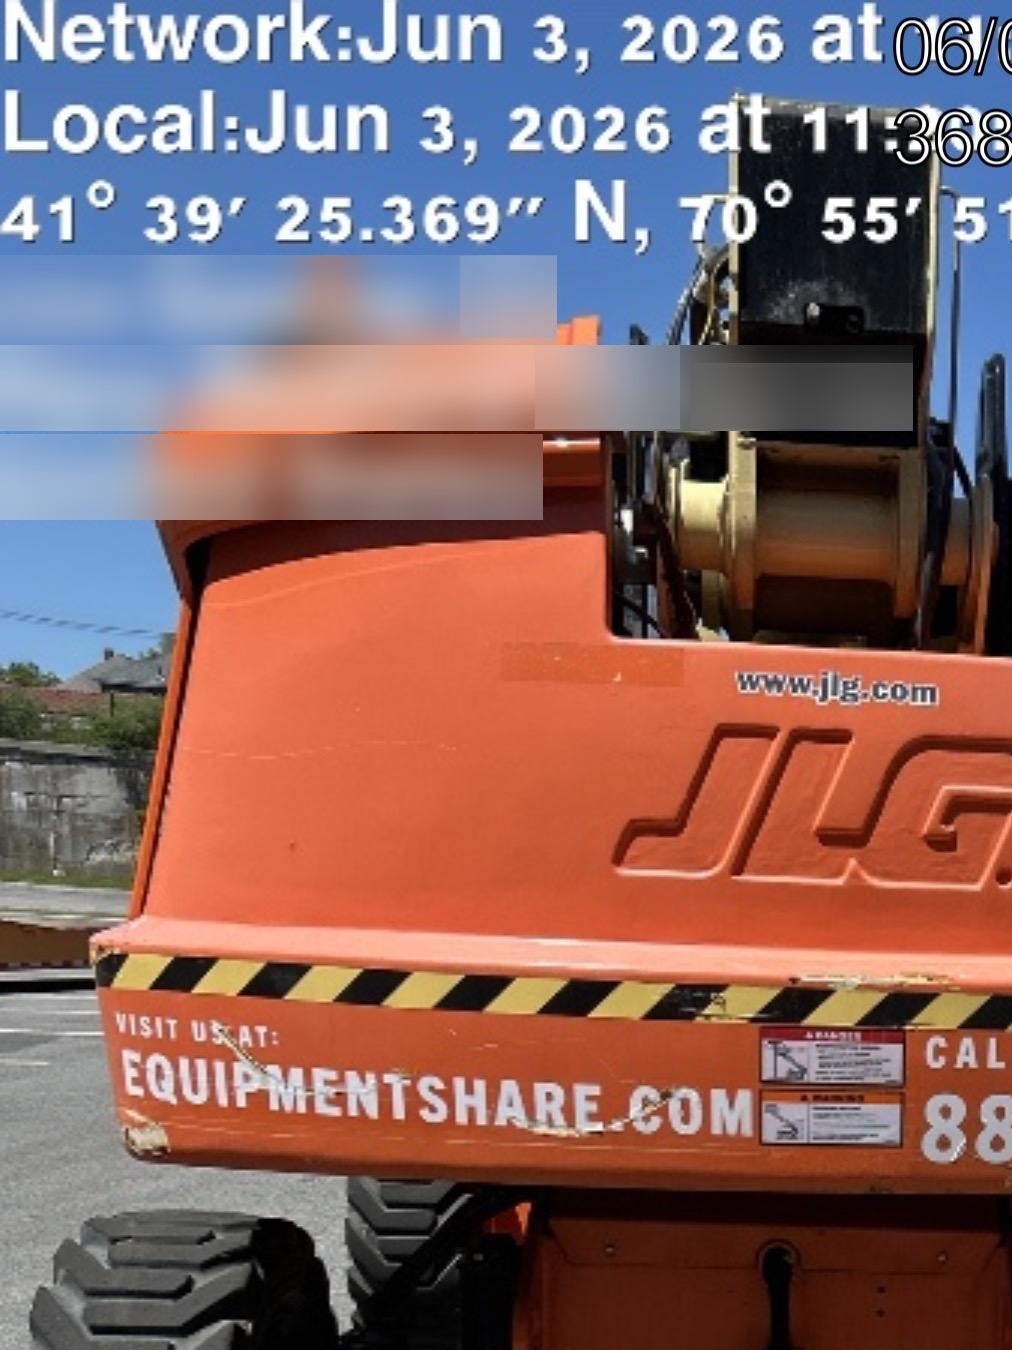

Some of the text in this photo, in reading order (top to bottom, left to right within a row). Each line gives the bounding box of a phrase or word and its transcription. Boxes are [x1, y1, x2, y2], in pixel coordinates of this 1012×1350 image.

[735, 669, 940, 707] www.jlg.com
[114, 1011, 281, 1048] VISIT US AT:
[120, 1048, 753, 1139] EQUIPMENTSHARE.COM
